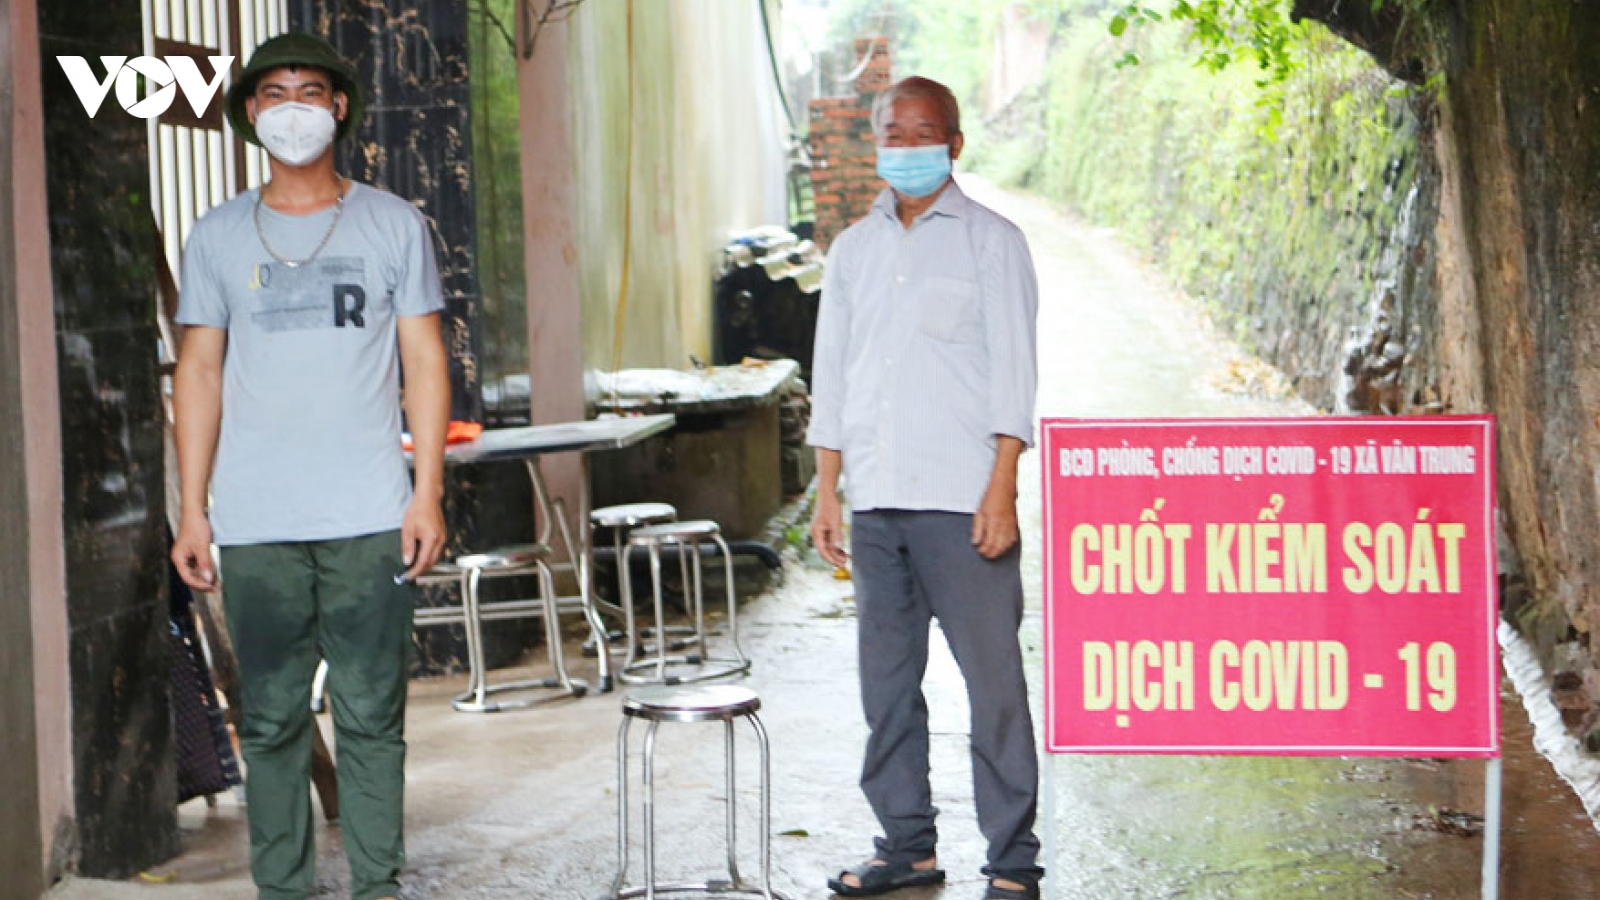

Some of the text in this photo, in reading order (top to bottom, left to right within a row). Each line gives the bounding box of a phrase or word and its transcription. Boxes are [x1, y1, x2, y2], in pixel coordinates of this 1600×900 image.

[332, 283, 366, 329] R
[1162, 435, 1220, 475] CHỐNG
[1222, 446, 1264, 482] DỊCH
[1266, 445, 1315, 475] COVID
[1330, 446, 1351, 474] 19
[1419, 445, 1476, 474] TRUNG
[1070, 493, 1466, 595] CHỐT KIỂM SOÁT
[1082, 640, 1195, 728] DỊCH
[1209, 639, 1349, 712] COVID
[1398, 641, 1458, 712] 19
